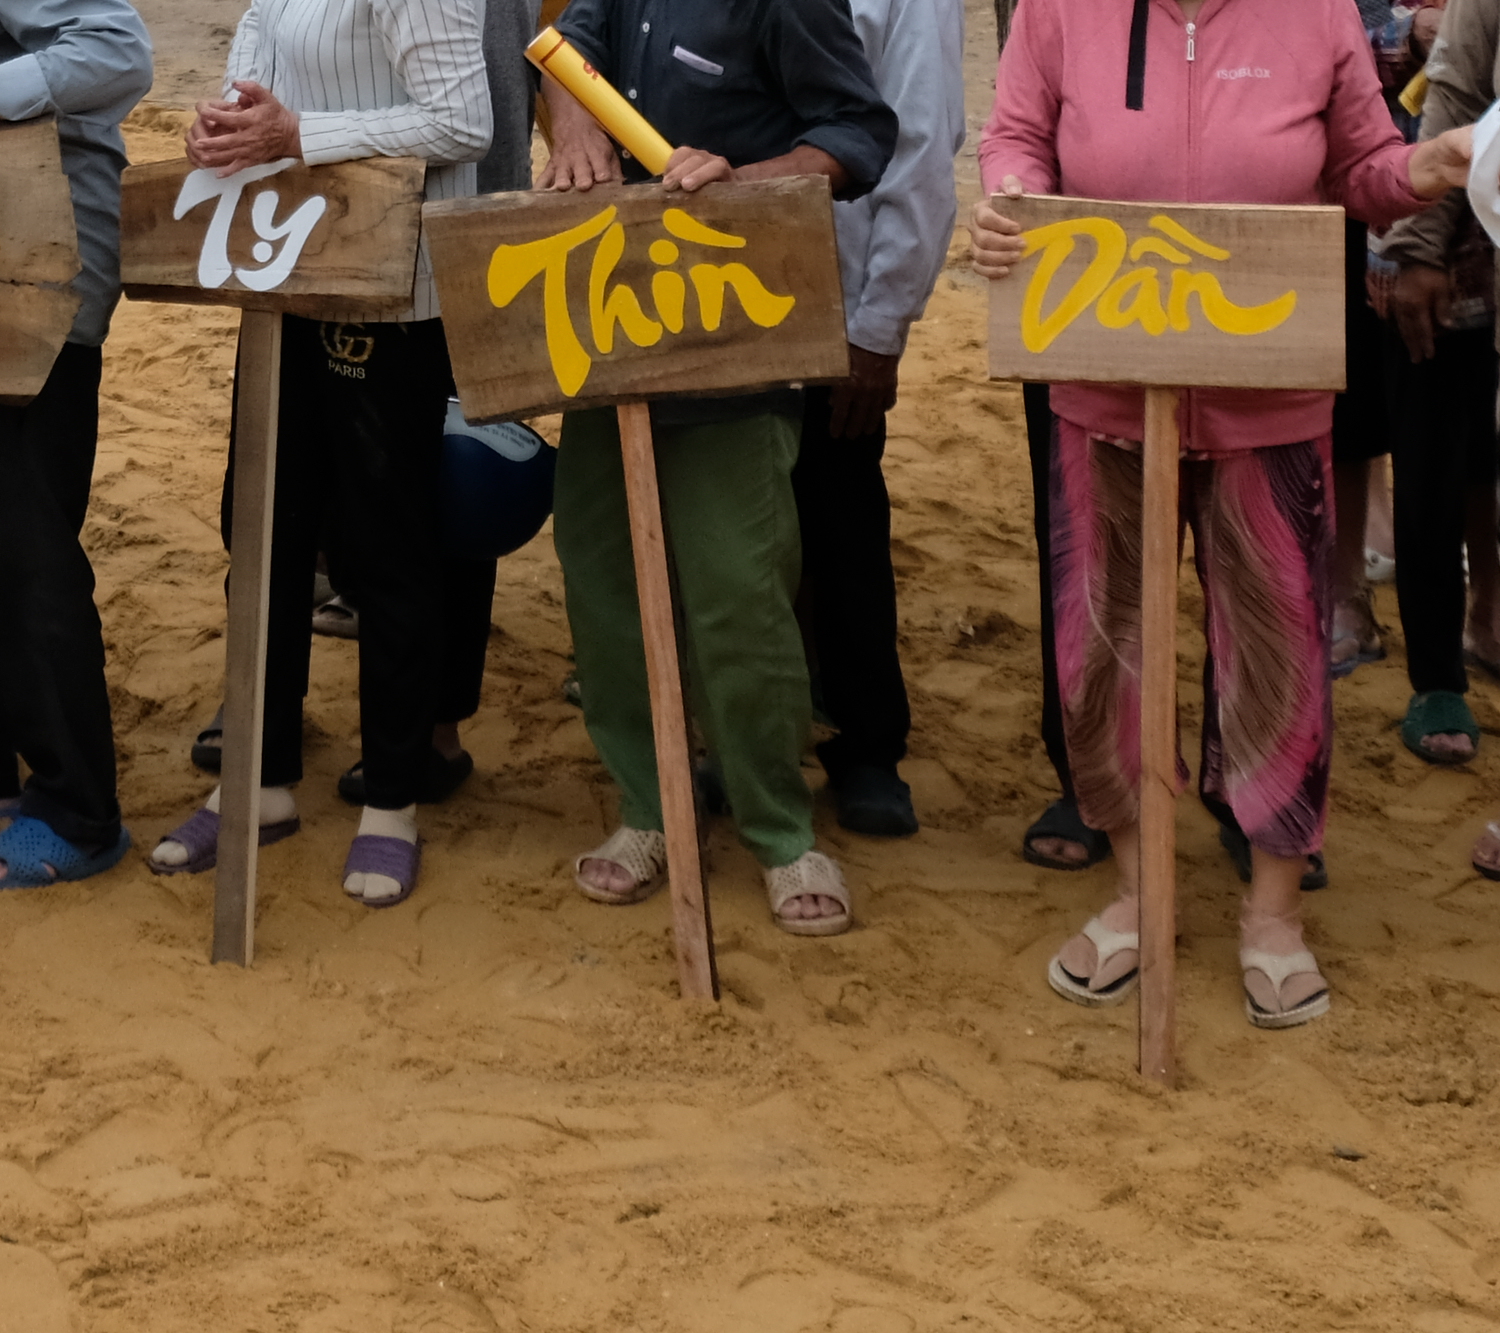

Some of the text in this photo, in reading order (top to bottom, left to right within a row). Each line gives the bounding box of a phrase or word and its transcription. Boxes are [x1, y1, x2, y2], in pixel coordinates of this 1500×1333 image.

[487, 205, 796, 397] Thìn
[1019, 214, 1296, 353] Dần
[328, 359, 365, 379] PARIS
